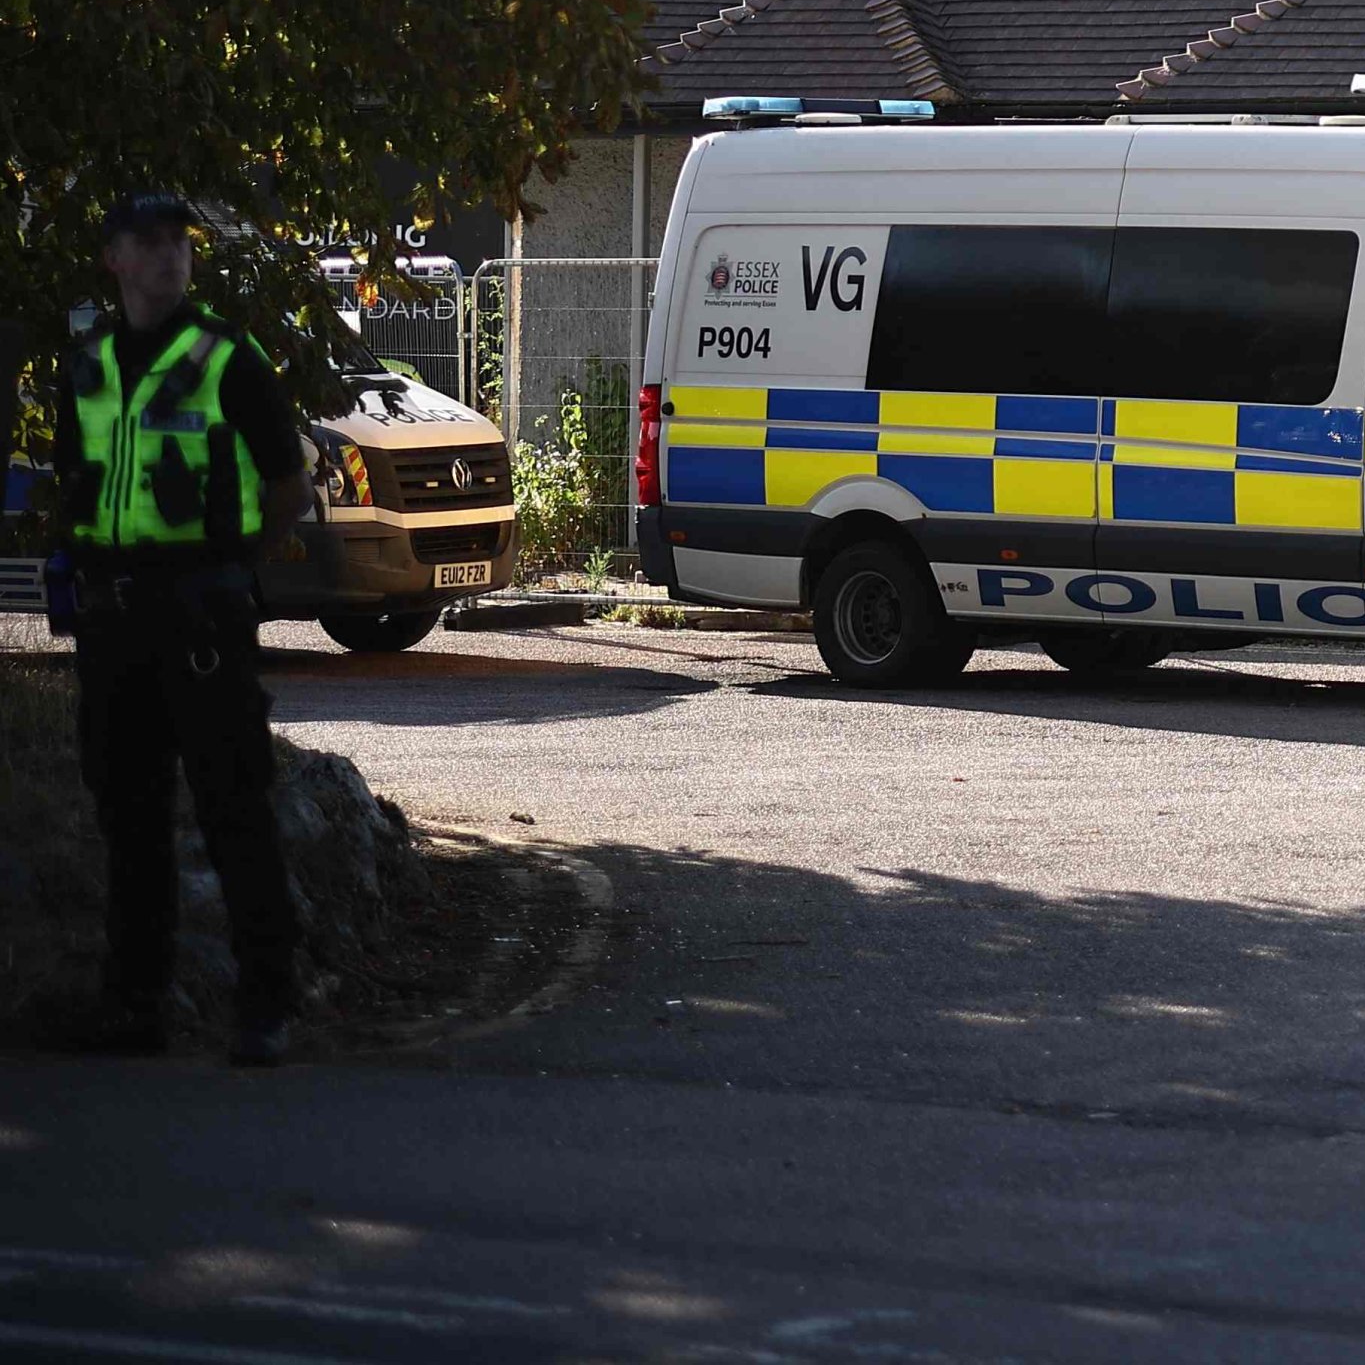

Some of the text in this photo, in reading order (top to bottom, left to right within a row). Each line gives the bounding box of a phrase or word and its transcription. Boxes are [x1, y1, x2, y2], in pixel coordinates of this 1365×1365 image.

[735, 261, 781, 278] ESSEX
[801, 245, 868, 312] VG
[733, 279, 779, 295] POLICE
[697, 325, 772, 359] P904
[366, 409, 475, 426] POLICE
[440, 564, 486, 584] EU12 FZR
